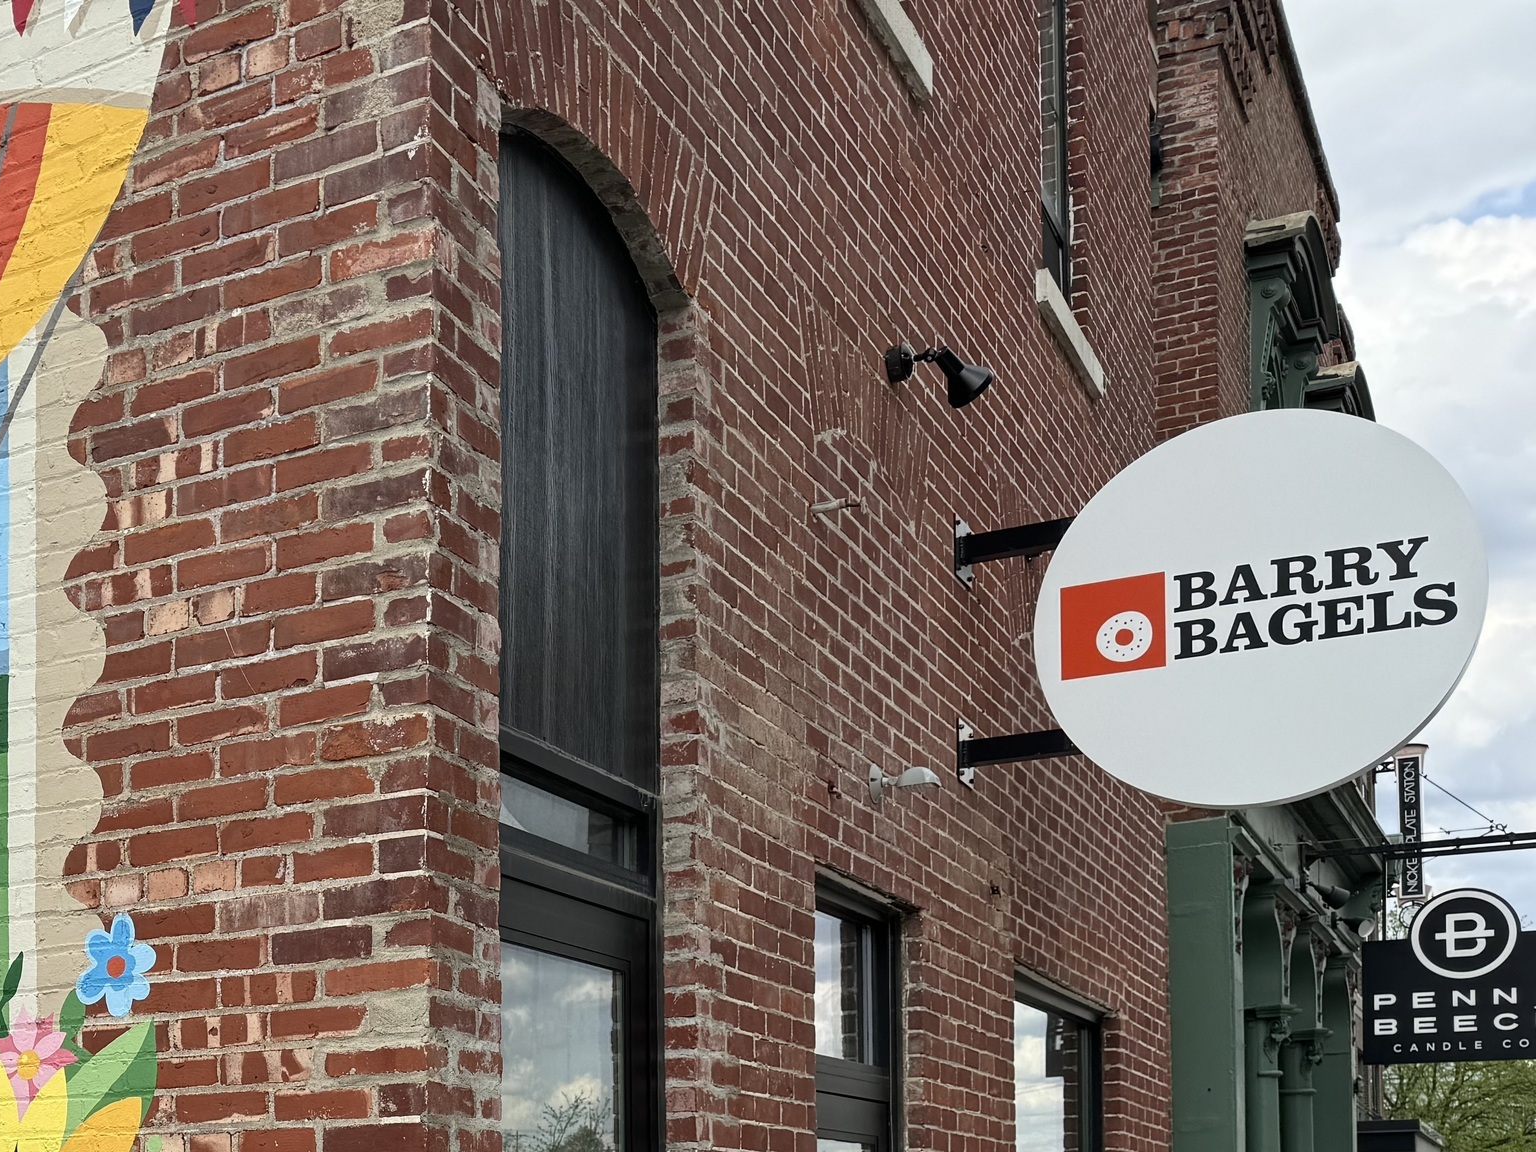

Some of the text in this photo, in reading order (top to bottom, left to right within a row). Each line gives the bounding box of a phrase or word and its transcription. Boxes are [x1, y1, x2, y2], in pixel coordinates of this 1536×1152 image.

[1172, 535, 1430, 614] BARRY
[1173, 581, 1459, 661] BAGELS
[1402, 761, 1419, 892] NICKE PLATE STATION
[1373, 987, 1518, 1011] PENN
[1373, 1012, 1536, 1036] BEEC
[1393, 1038, 1531, 1053] CANDLE CO
